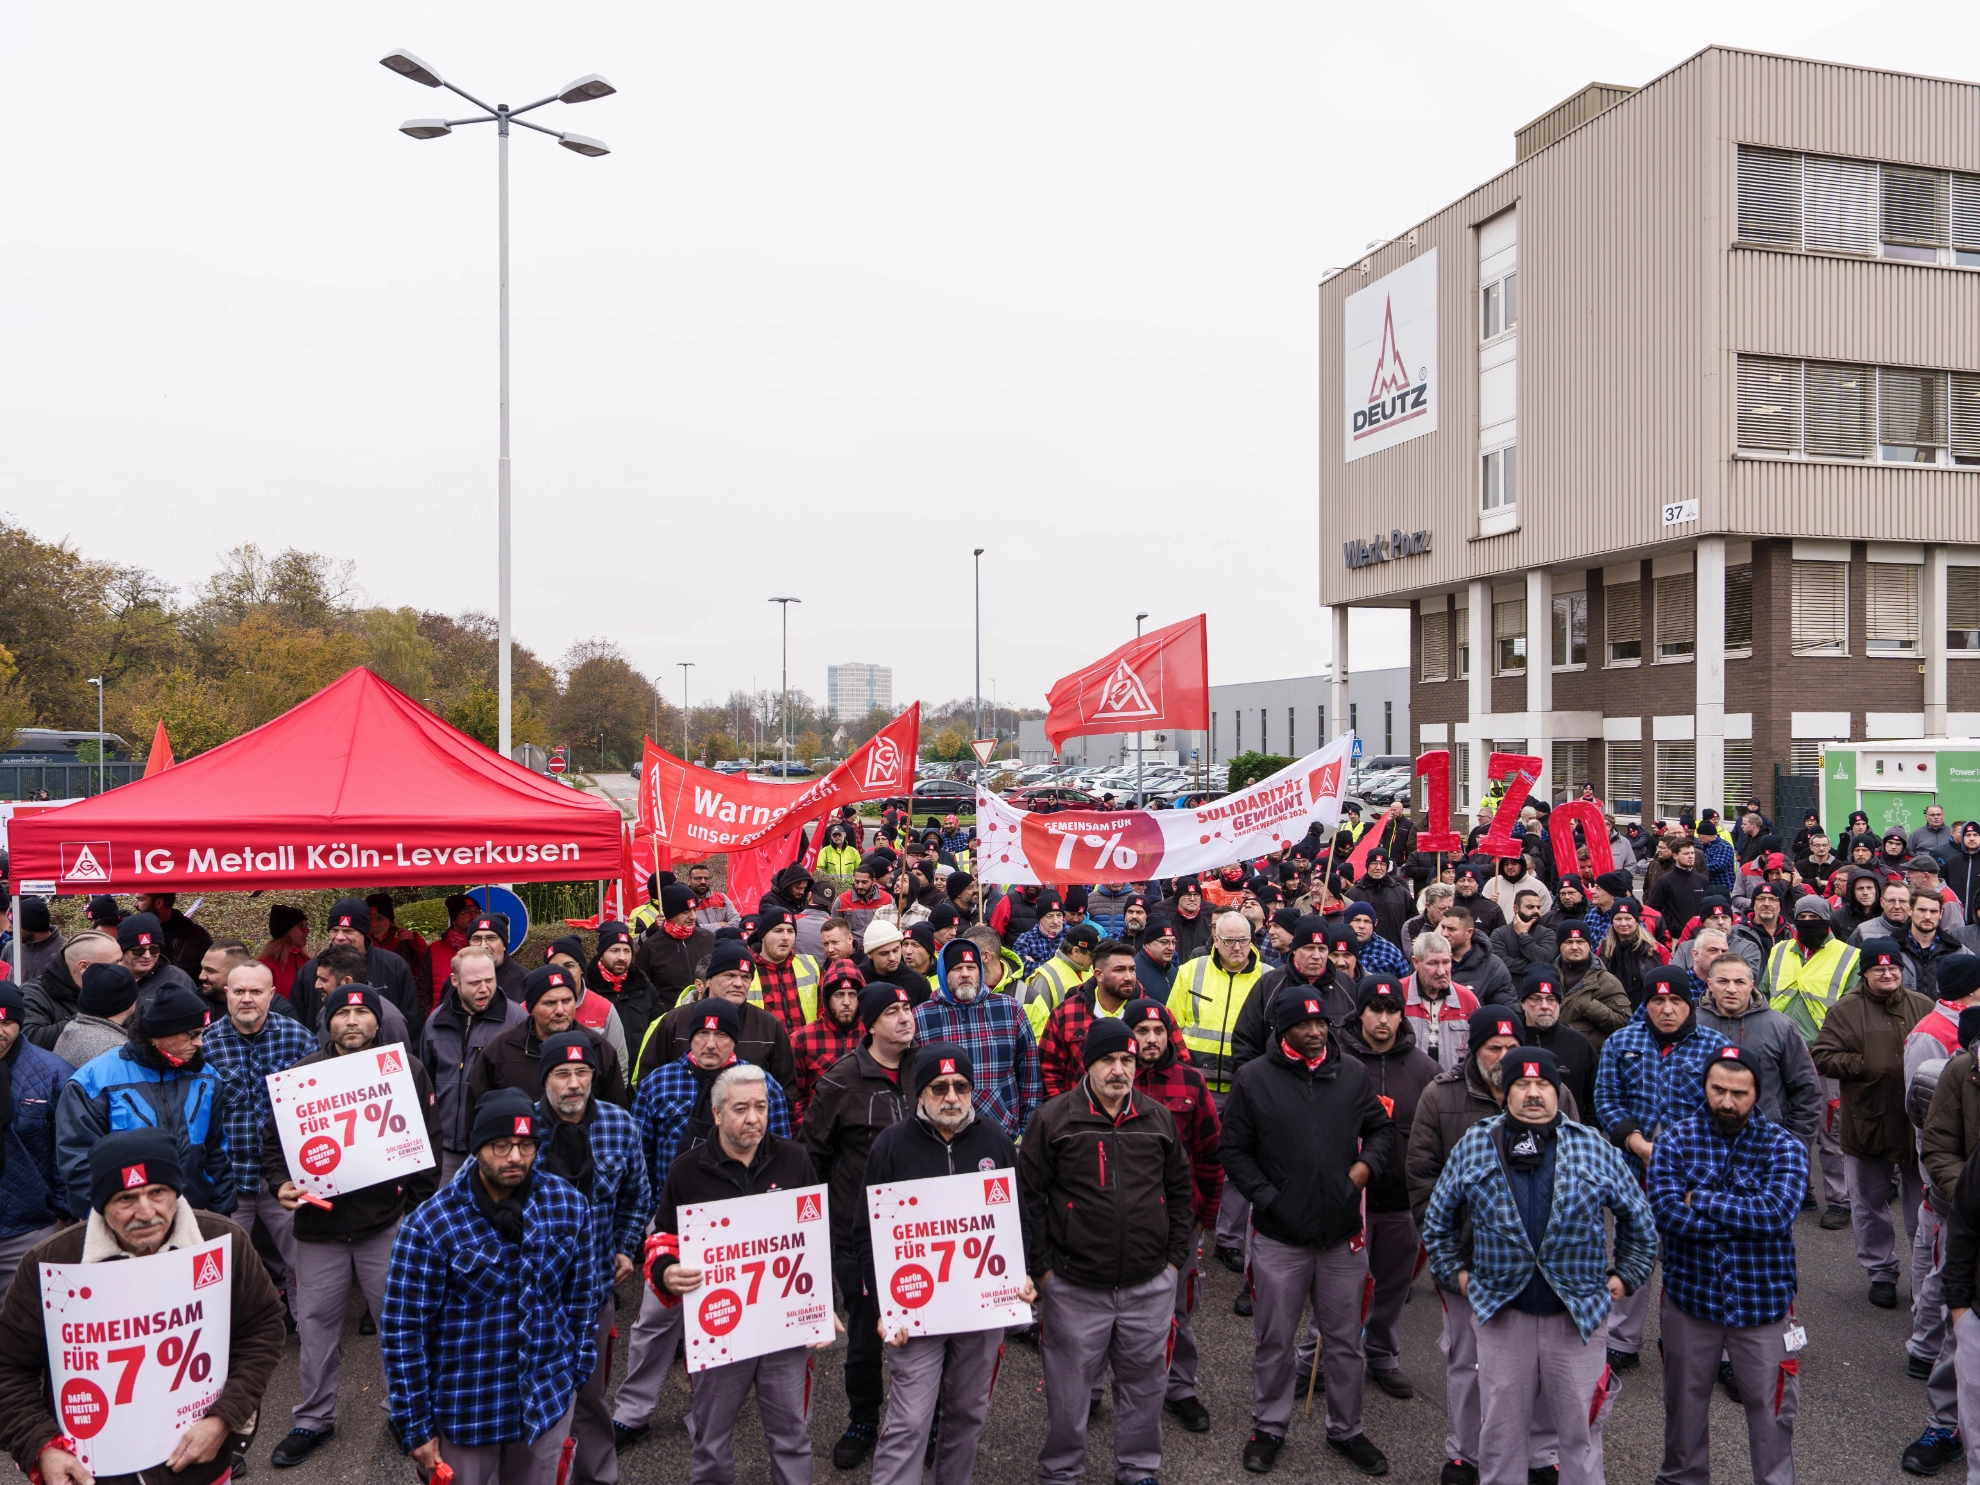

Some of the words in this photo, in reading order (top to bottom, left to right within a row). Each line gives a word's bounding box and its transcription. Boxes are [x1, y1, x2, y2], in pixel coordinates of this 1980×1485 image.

[1353, 382, 1427, 433] DEUTZ
[1665, 505, 1683, 521] 37
[1343, 534, 1387, 569] Werk
[1390, 528, 1430, 559] Porz
[1196, 778, 1304, 824] SOLIDARITÄT
[1232, 791, 1304, 831] GEWINNT
[1289, 808, 1308, 818] 2024
[1044, 821, 1110, 831] GEMEINSAM
[1111, 818, 1132, 830] FÜR
[687, 823, 740, 845] unser
[1048, 827, 1138, 870] 7%
[134, 848, 175, 874] IG
[186, 845, 295, 873] Metall
[306, 840, 580, 869] Köln-Leverkusen
[295, 1082, 393, 1119] GEMEINSAM
[299, 1116, 331, 1136] FÜR
[307, 1143, 329, 1156] DAFÜR
[385, 1138, 423, 1153] SOLIDARITÄT
[398, 1144, 424, 1156] GEWINNT
[305, 1148, 336, 1164] STREITEN
[314, 1158, 331, 1168] WIR!
[892, 1214, 996, 1241] GEMEINSAM
[703, 1231, 806, 1265] GEMEINSAM
[894, 1240, 926, 1260] FÜR
[704, 1264, 736, 1286] FÜR
[899, 1273, 922, 1285] DAFÜR
[896, 1281, 928, 1293] STREITEN
[905, 1290, 922, 1300] WIR!
[708, 1298, 731, 1312] DAFÜR
[993, 1294, 1019, 1303] GEWINN
[704, 1305, 737, 1321] STREITEN
[786, 1304, 826, 1318] SOLIDARITÄT
[798, 1311, 826, 1322] GEWINNT
[61, 1300, 203, 1345] GEMEINSAM
[713, 1316, 730, 1327] WIR!
[63, 1346, 100, 1372] FÜR
[68, 1391, 92, 1404] DAFÜR
[65, 1402, 100, 1415] STREITEN
[73, 1414, 92, 1425] WIR!
